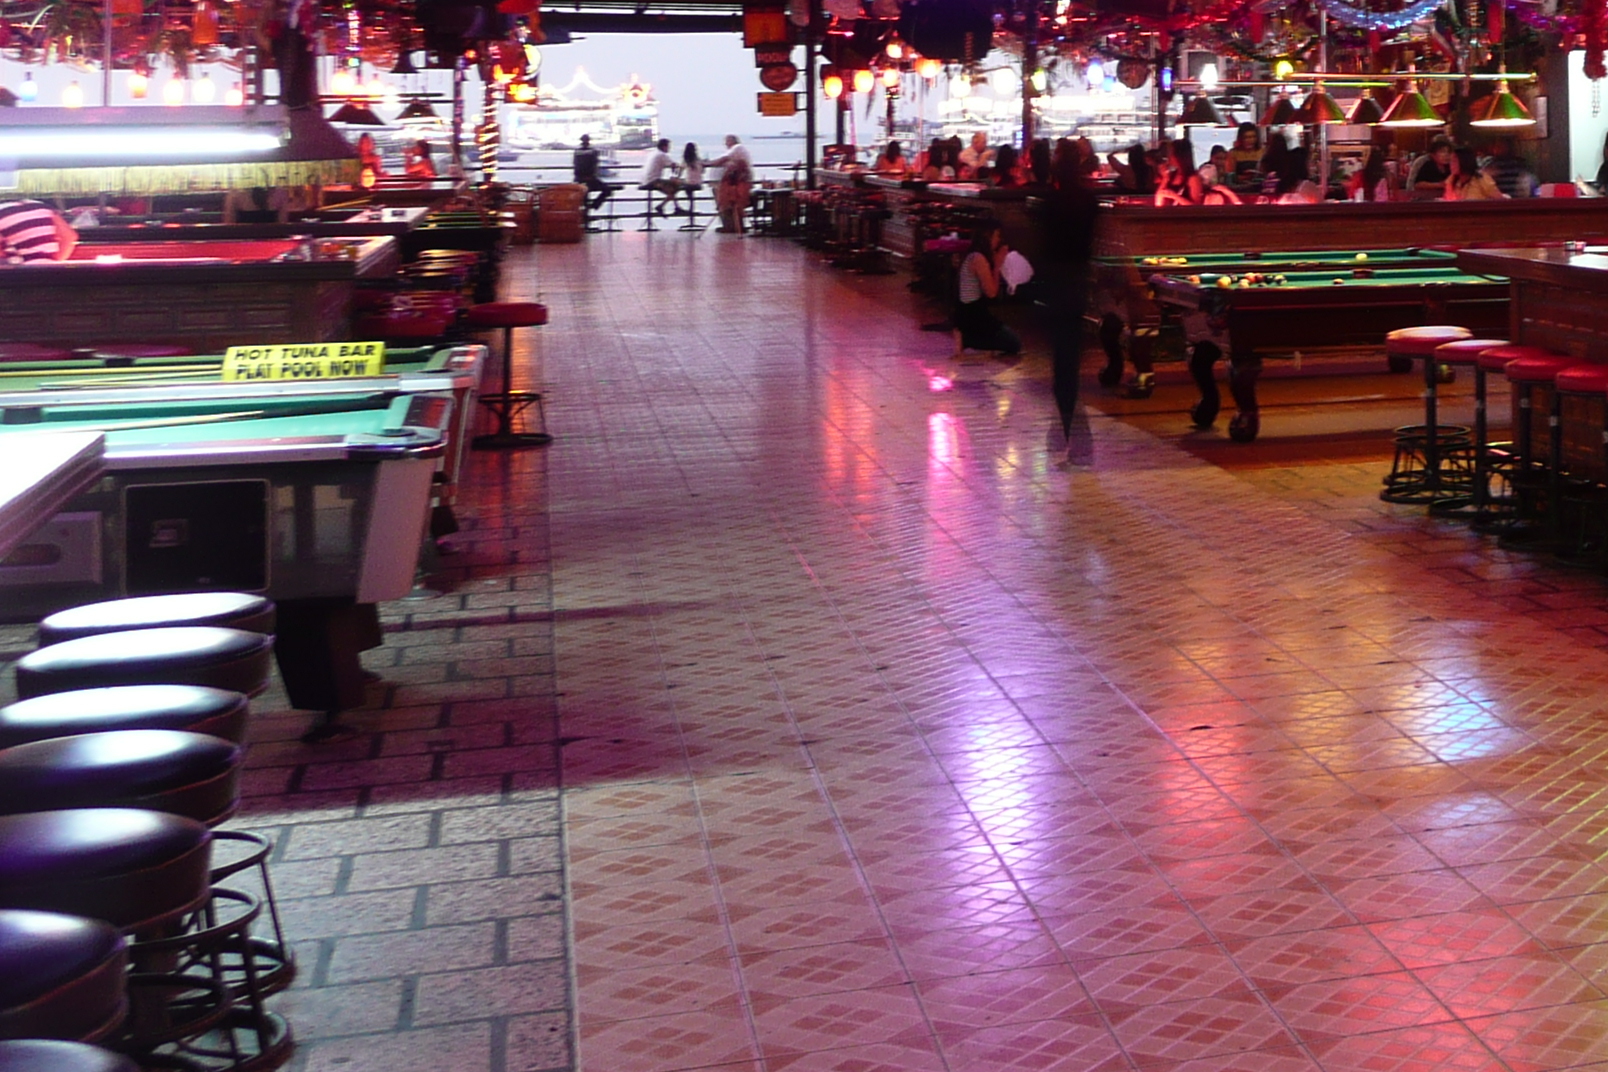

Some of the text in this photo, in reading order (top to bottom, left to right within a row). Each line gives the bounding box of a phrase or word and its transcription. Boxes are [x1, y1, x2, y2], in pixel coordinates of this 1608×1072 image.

[235, 344, 375, 361] HOT TUNA BAR
[280, 362, 322, 378] POOL
[330, 359, 369, 376] NOW
